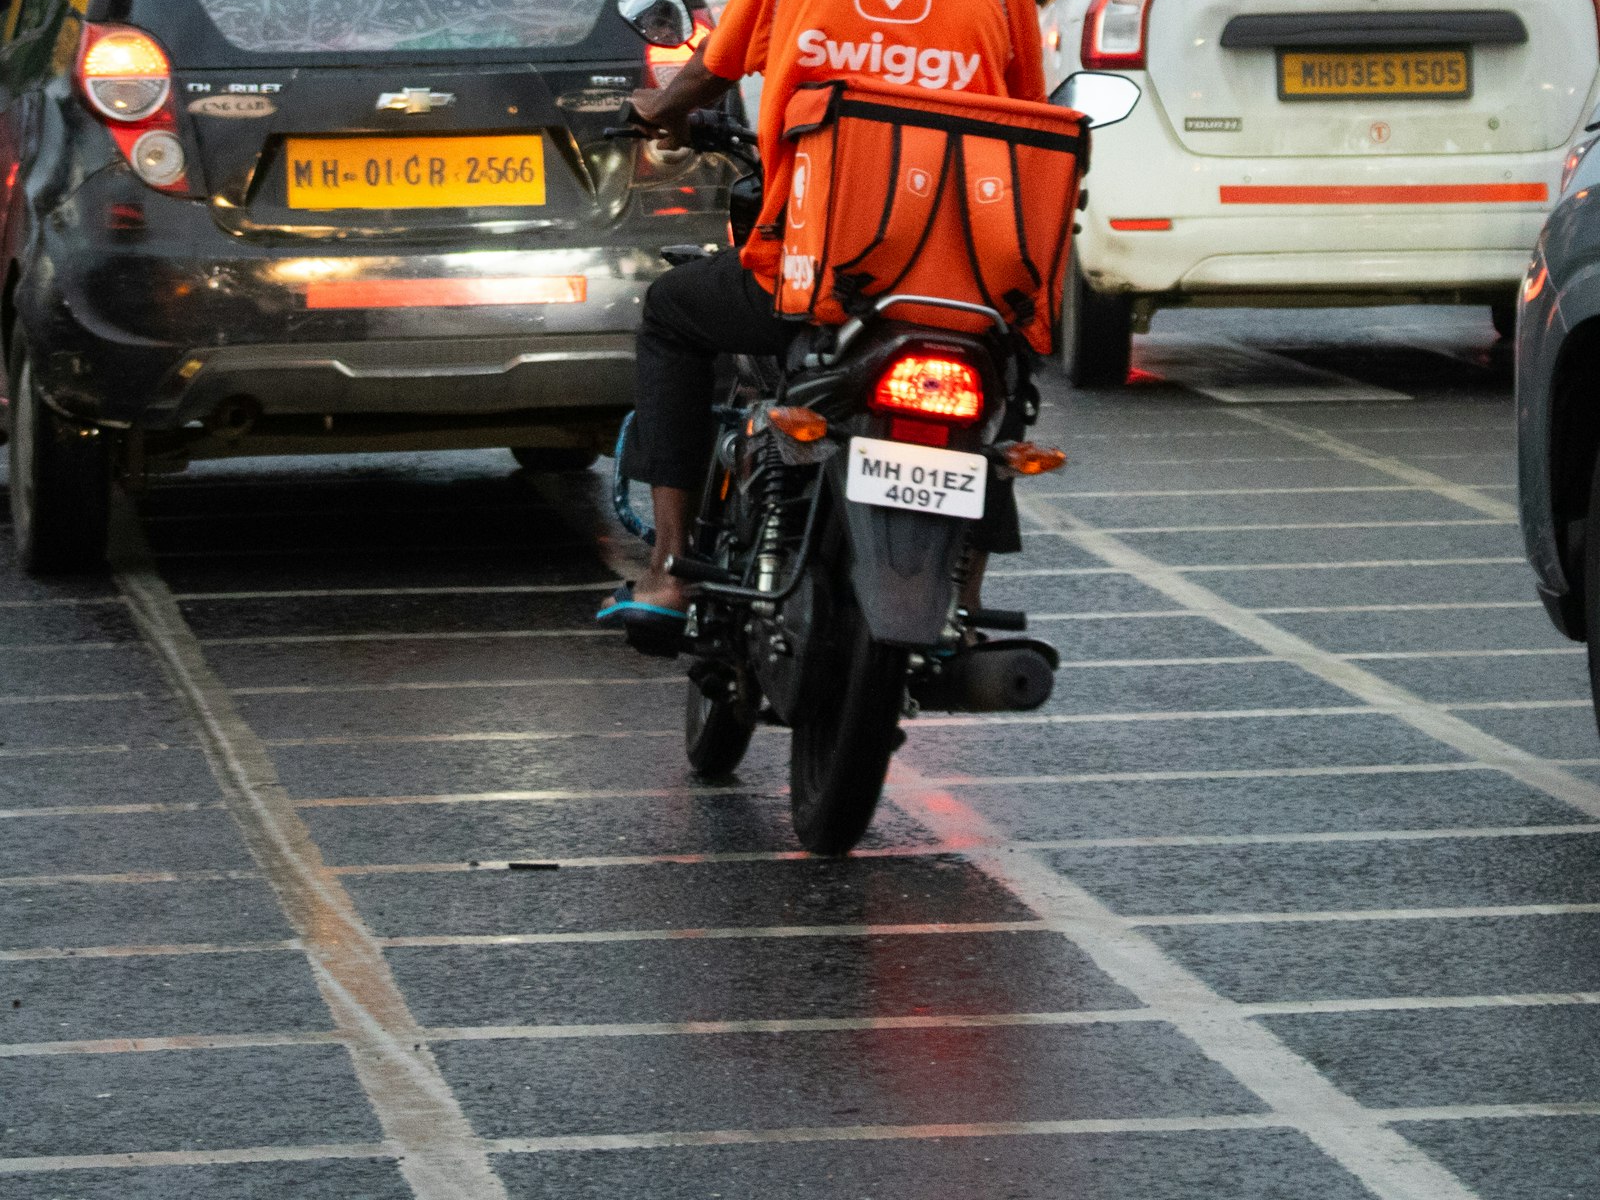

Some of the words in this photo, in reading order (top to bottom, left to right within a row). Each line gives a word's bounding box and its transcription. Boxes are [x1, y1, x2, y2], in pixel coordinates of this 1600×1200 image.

[797, 29, 981, 91] Swiggy
[862, 457, 901, 481] MH
[911, 466, 975, 493] 01EZ
[885, 484, 947, 509] 4097
